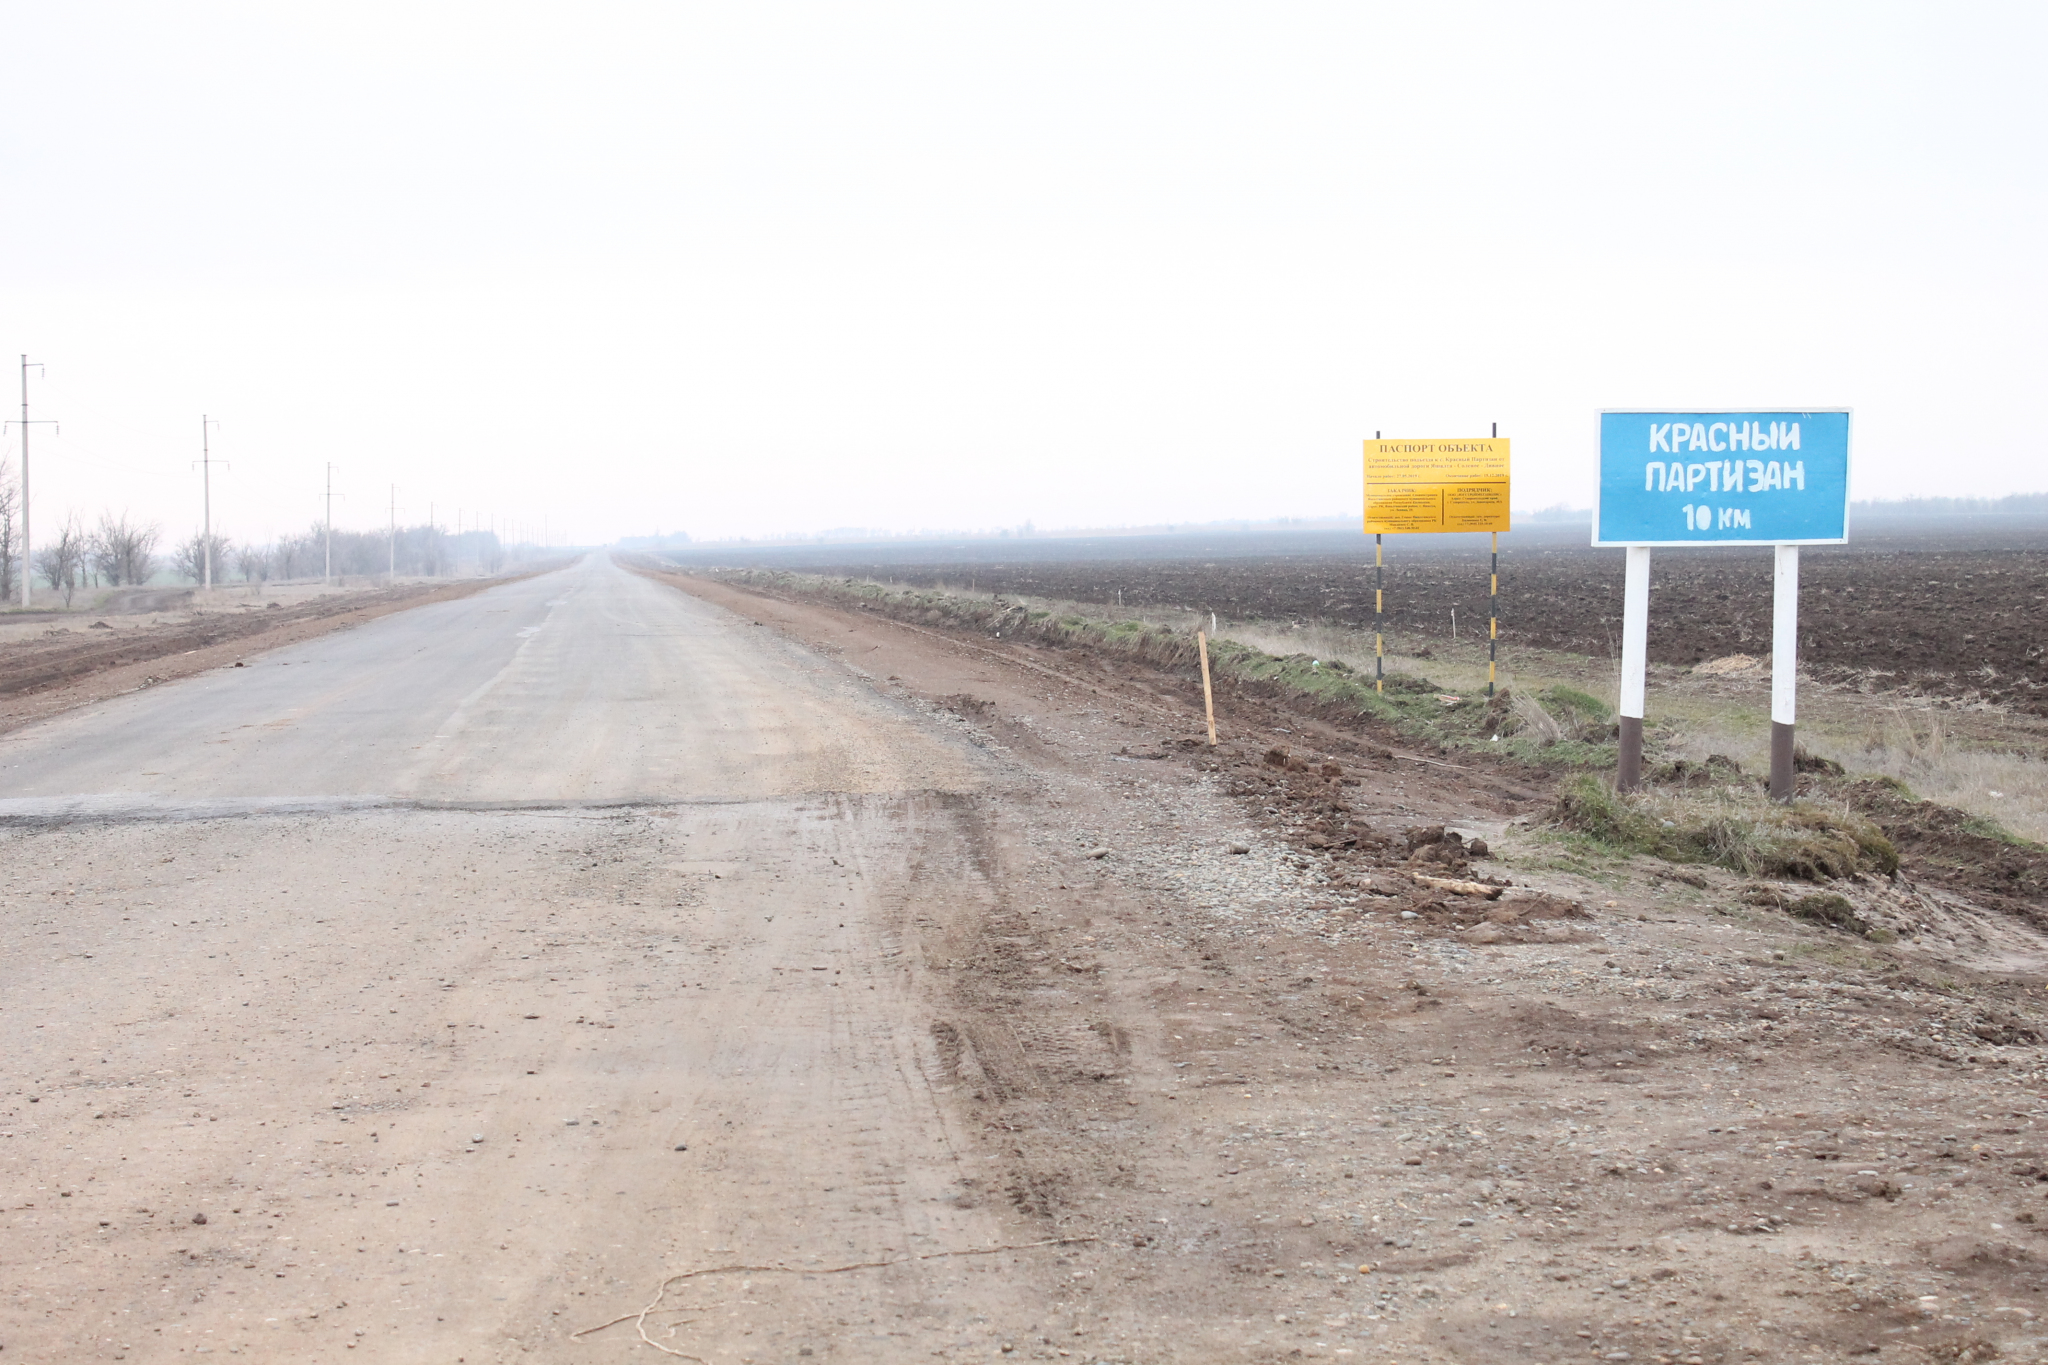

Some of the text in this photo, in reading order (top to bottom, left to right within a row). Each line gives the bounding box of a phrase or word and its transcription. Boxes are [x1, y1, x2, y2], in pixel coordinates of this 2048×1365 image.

[1380, 443, 1493, 453] ПАСПОРТ ОБЪЕКТА
[1645, 460, 1804, 492] ПАРТИЗАН
[1682, 504, 1712, 531] 10
